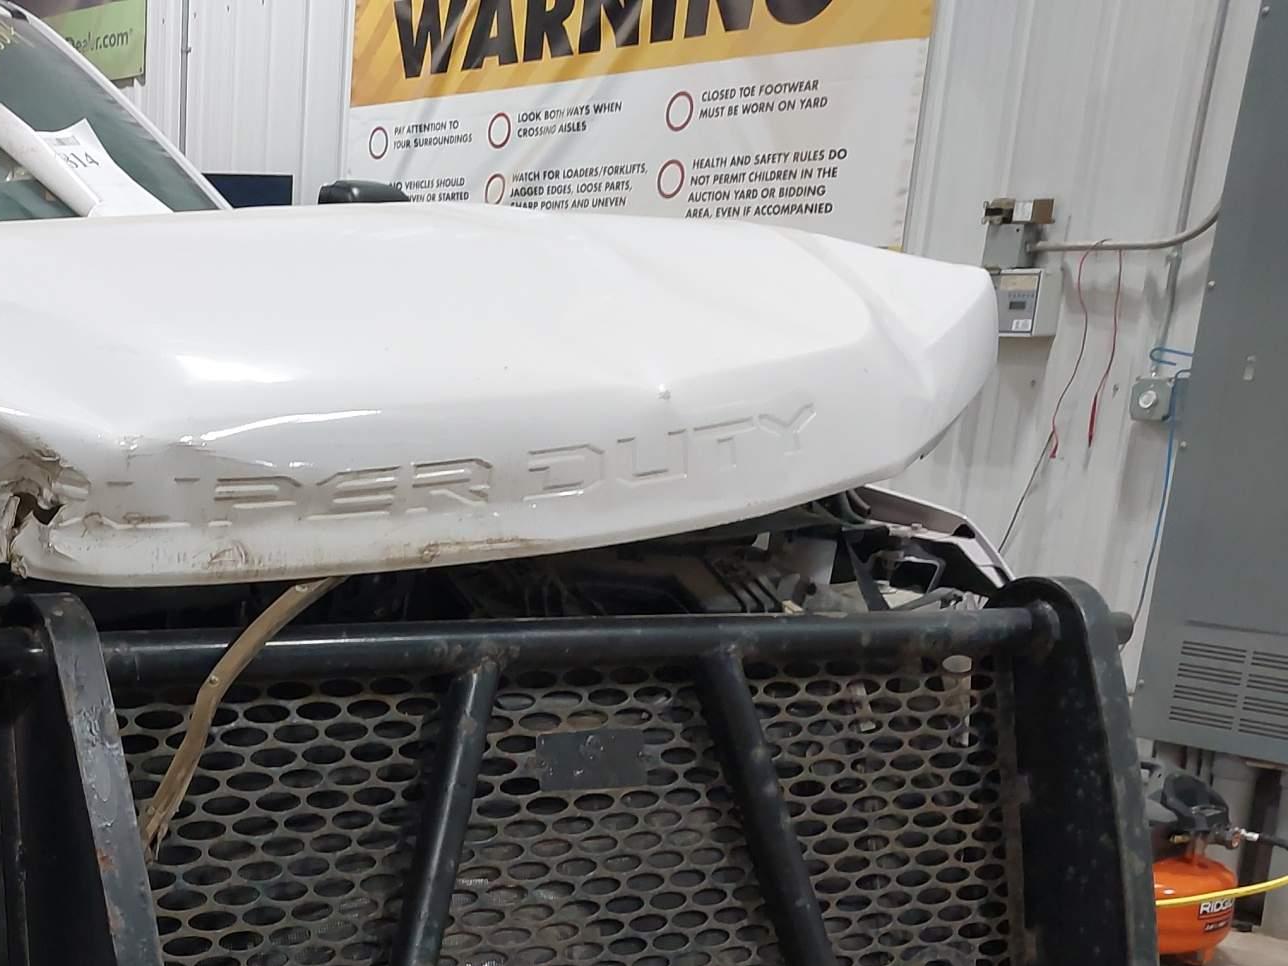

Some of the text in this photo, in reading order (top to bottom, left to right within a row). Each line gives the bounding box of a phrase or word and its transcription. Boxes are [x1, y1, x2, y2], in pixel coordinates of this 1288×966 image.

[702, 80, 819, 102] CLOSED TOE FOOTWEAR
[518, 101, 622, 123] LOOK BOTH WAYS WHEN
[699, 96, 828, 120] MUST BE WORN ON YARD
[407, 122, 447, 134] ATTENTION
[450, 120, 459, 130] TO
[518, 121, 587, 138] CROSSING AISLES
[393, 134, 472, 150] YOUR SURROUNDINGS
[692, 148, 848, 170] HEALTH AND SAFETY RULES DO
[512, 162, 648, 182] WATCH FOR LOADERS/FORKLIFTS,
[690, 166, 838, 186] NOT PERMIT CHILDREN IN THE
[405, 180, 434, 190] VEHICLES
[436, 178, 464, 188] SHOULD
[510, 180, 632, 198] JAGGED EDGES, LOOSE PARTS,
[426, 193, 436, 202] OR
[439, 192, 469, 202] STARTED
[688, 185, 826, 202] AUCTION YARD OR BIDDING
[540, 200, 568, 210] POINTS
[572, 198, 590, 209] AND
[592, 196, 626, 208] UNEVEN
[685, 202, 833, 218] AREA, EVEN IF ACCOMPANIED
[521, 400, 817, 502] DUTY
